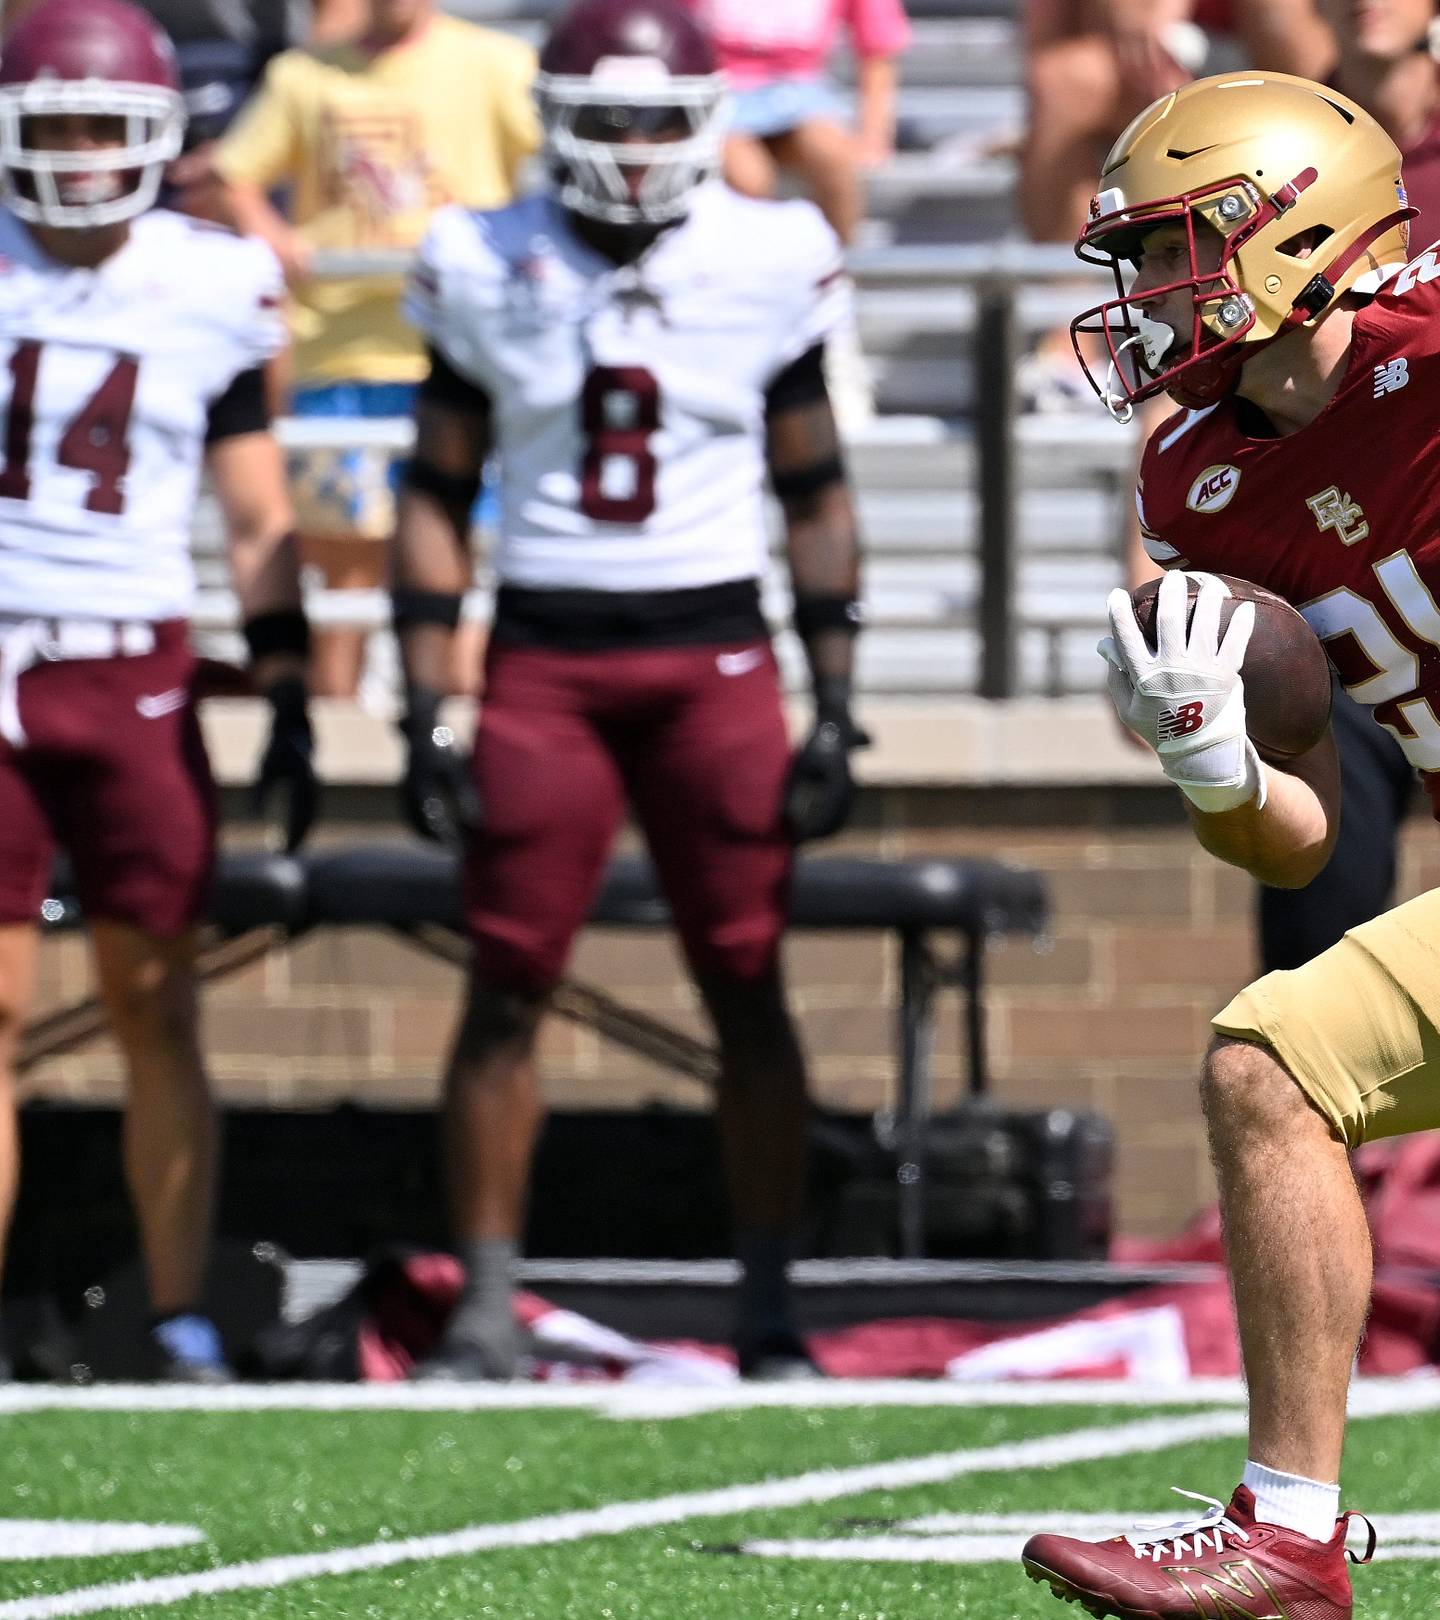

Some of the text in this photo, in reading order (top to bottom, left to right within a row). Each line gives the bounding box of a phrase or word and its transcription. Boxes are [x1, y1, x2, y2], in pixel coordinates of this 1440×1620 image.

[0, 336, 140, 516] 14
[580, 364, 660, 524] 8
[1196, 467, 1233, 506] ACC
